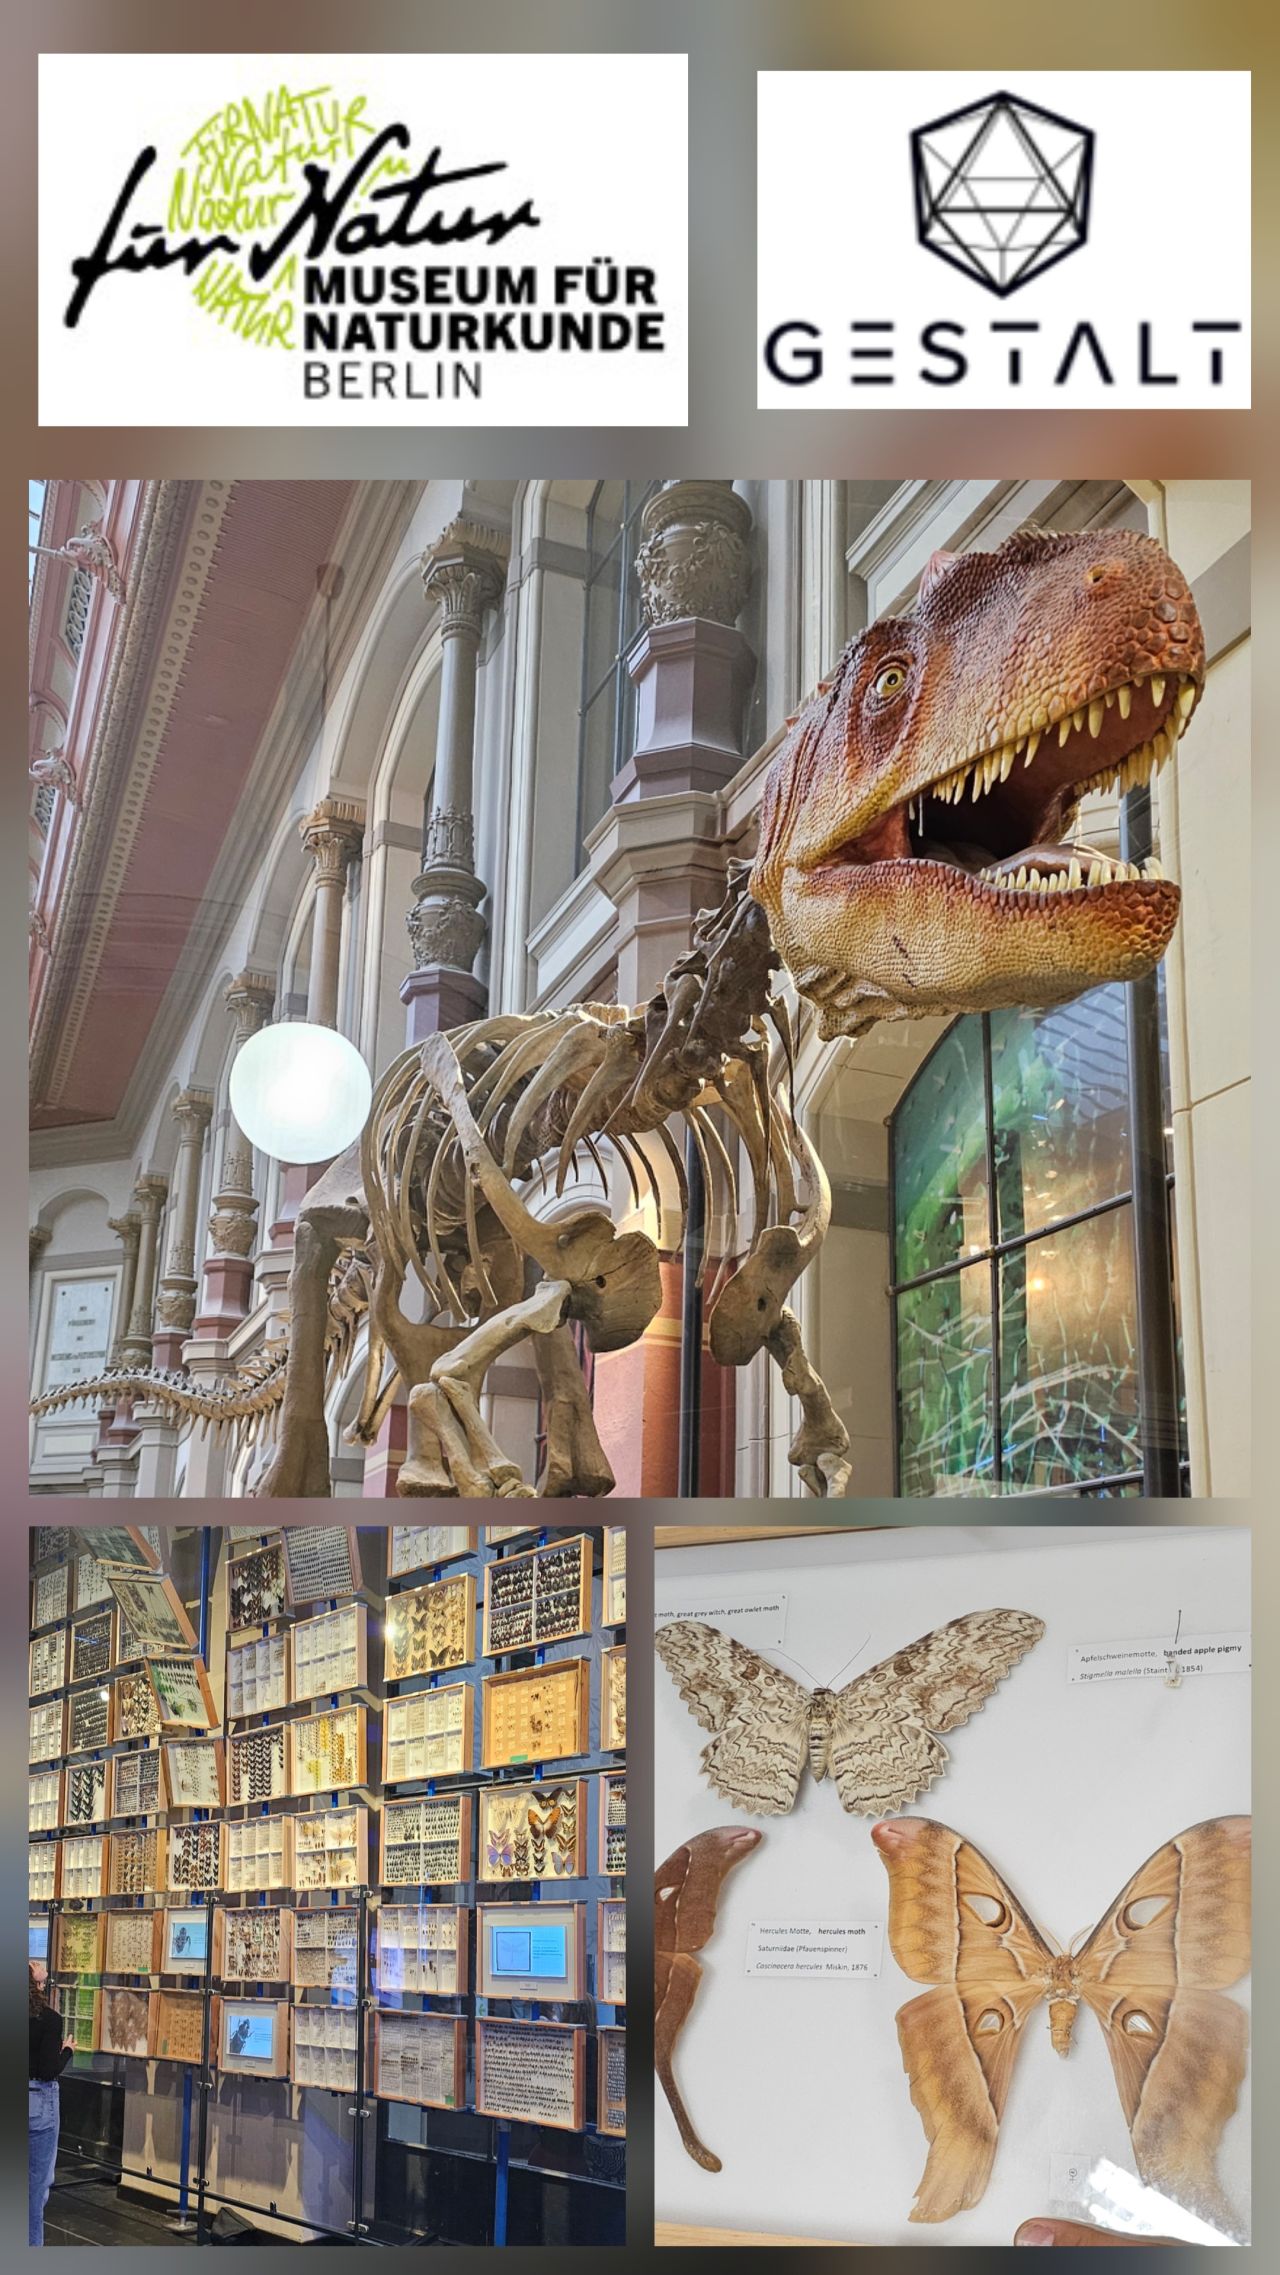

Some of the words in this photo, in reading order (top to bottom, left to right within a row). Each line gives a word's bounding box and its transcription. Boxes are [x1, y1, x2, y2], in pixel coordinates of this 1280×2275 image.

[709, 1608, 727, 1616] witch,
[1163, 1647, 1192, 1657] banded
[1194, 1645, 1216, 1655] apple
[1217, 1645, 1242, 1653] pigmy
[1080, 1669, 1113, 1680] Stigmella
[1182, 1664, 1203, 1673] 1854)
[760, 1927, 788, 1935] Hercules
[789, 1927, 812, 1935] Motte,
[818, 1927, 846, 1935] hercules
[847, 1927, 866, 1935] moth
[795, 1962, 823, 1970] hercules
[825, 1963, 850, 1971] Miskin,
[851, 1963, 868, 1971] 1876
